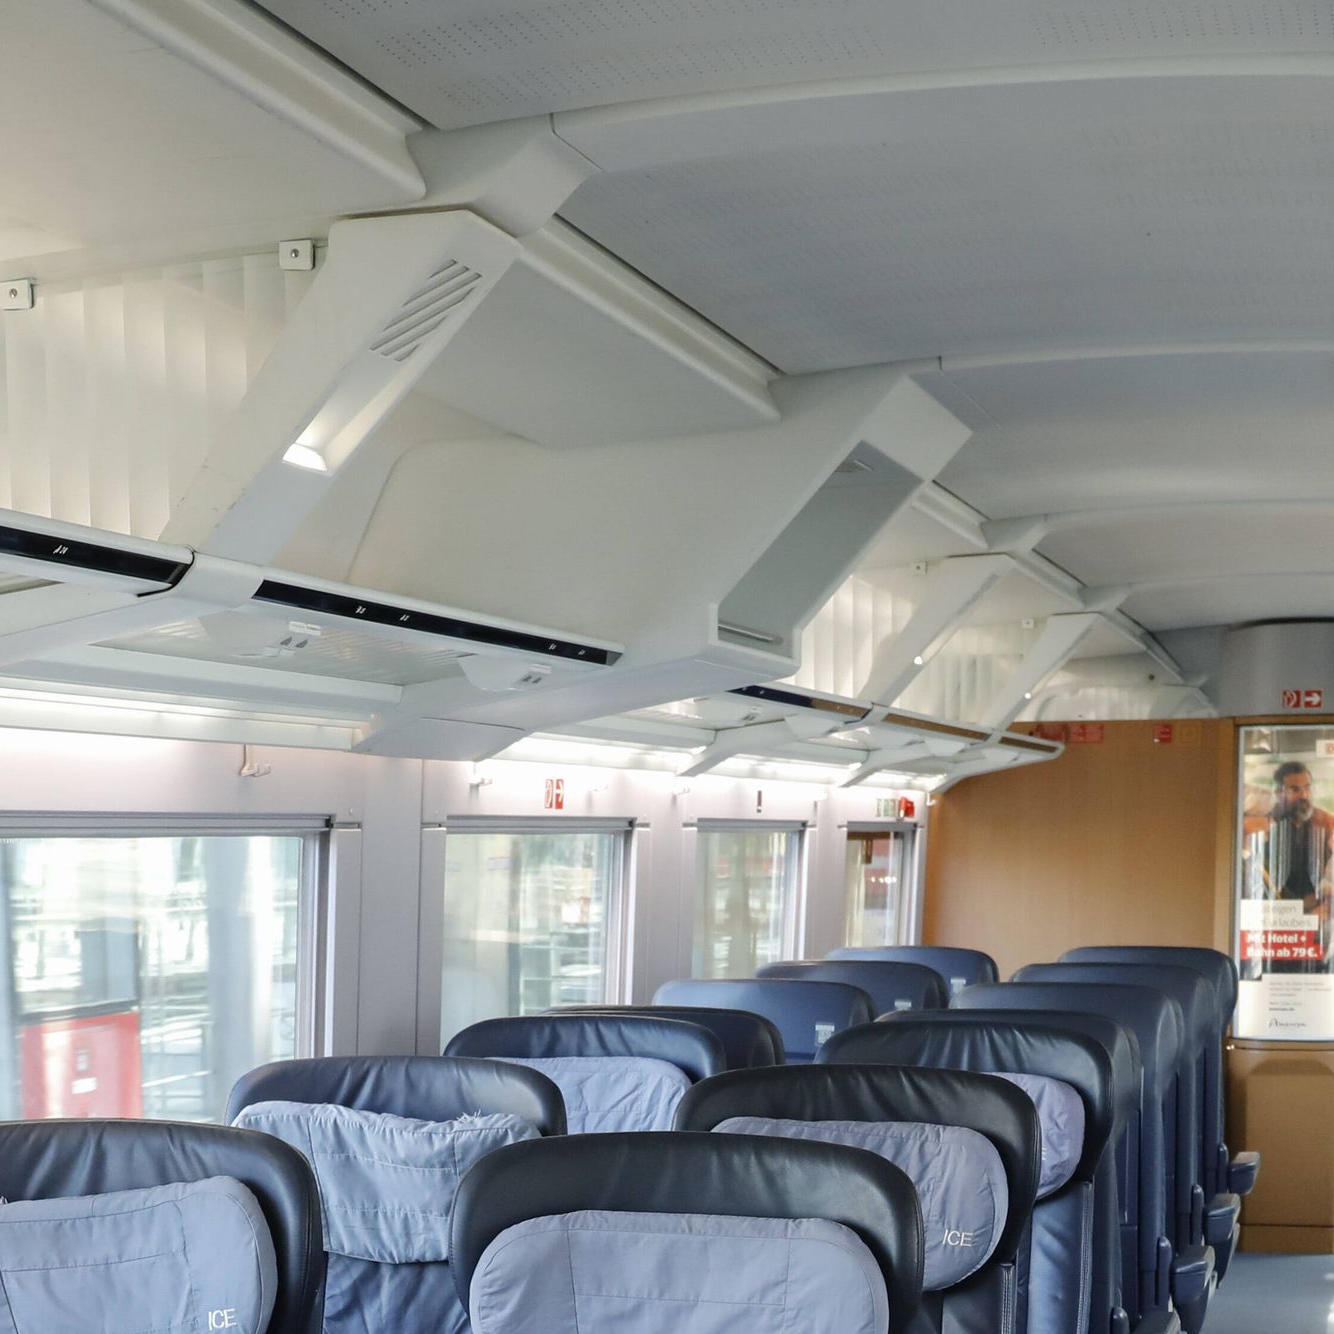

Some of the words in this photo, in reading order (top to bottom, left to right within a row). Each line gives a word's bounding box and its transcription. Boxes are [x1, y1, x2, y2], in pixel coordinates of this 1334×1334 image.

[1268, 933, 1298, 943] Hotel
[1247, 948, 1275, 957] Bahn
[1276, 948, 1290, 957] ab
[942, 1229, 973, 1247] ICE
[208, 1308, 237, 1331] ICE
